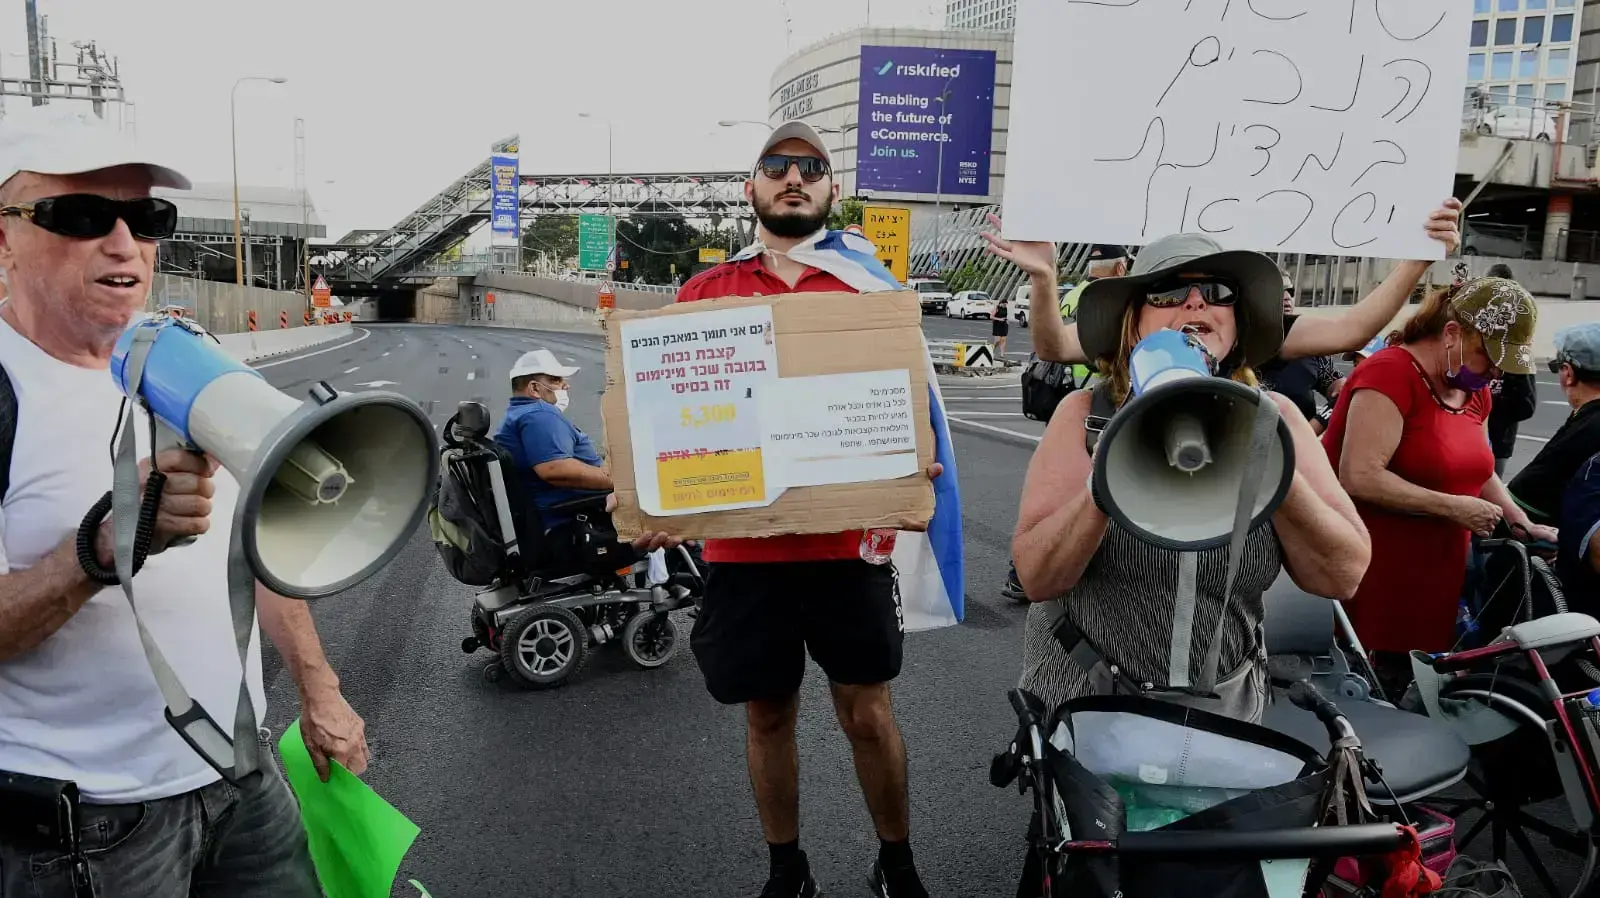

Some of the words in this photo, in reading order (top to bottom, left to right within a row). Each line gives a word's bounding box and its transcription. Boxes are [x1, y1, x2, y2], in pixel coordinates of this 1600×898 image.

[896, 63, 960, 78] riskified
[1156, 36, 1432, 124] הנכים
[872, 93, 929, 108] Enabling
[871, 111, 893, 122] the
[896, 111, 935, 124] future
[938, 113, 953, 125] of
[871, 128, 952, 142] eCommerce.
[870, 145, 897, 158] Join
[901, 149, 919, 158] us.
[1093, 116, 1407, 187] במדינת
[870, 214, 904, 223] יציאה
[874, 244, 899, 253] XIT
[701, 328, 727, 342] תומך
[730, 326, 746, 337] אני
[631, 336, 660, 349] הנכים
[663, 331, 699, 347] במאבק
[661, 350, 691, 364] נכות
[695, 346, 736, 361] קצבת
[690, 363, 720, 376] שכר
[724, 359, 767, 374] בגובה
[635, 368, 686, 382] מינימום
[671, 381, 709, 394] בסיסי
[714, 379, 731, 391] זה
